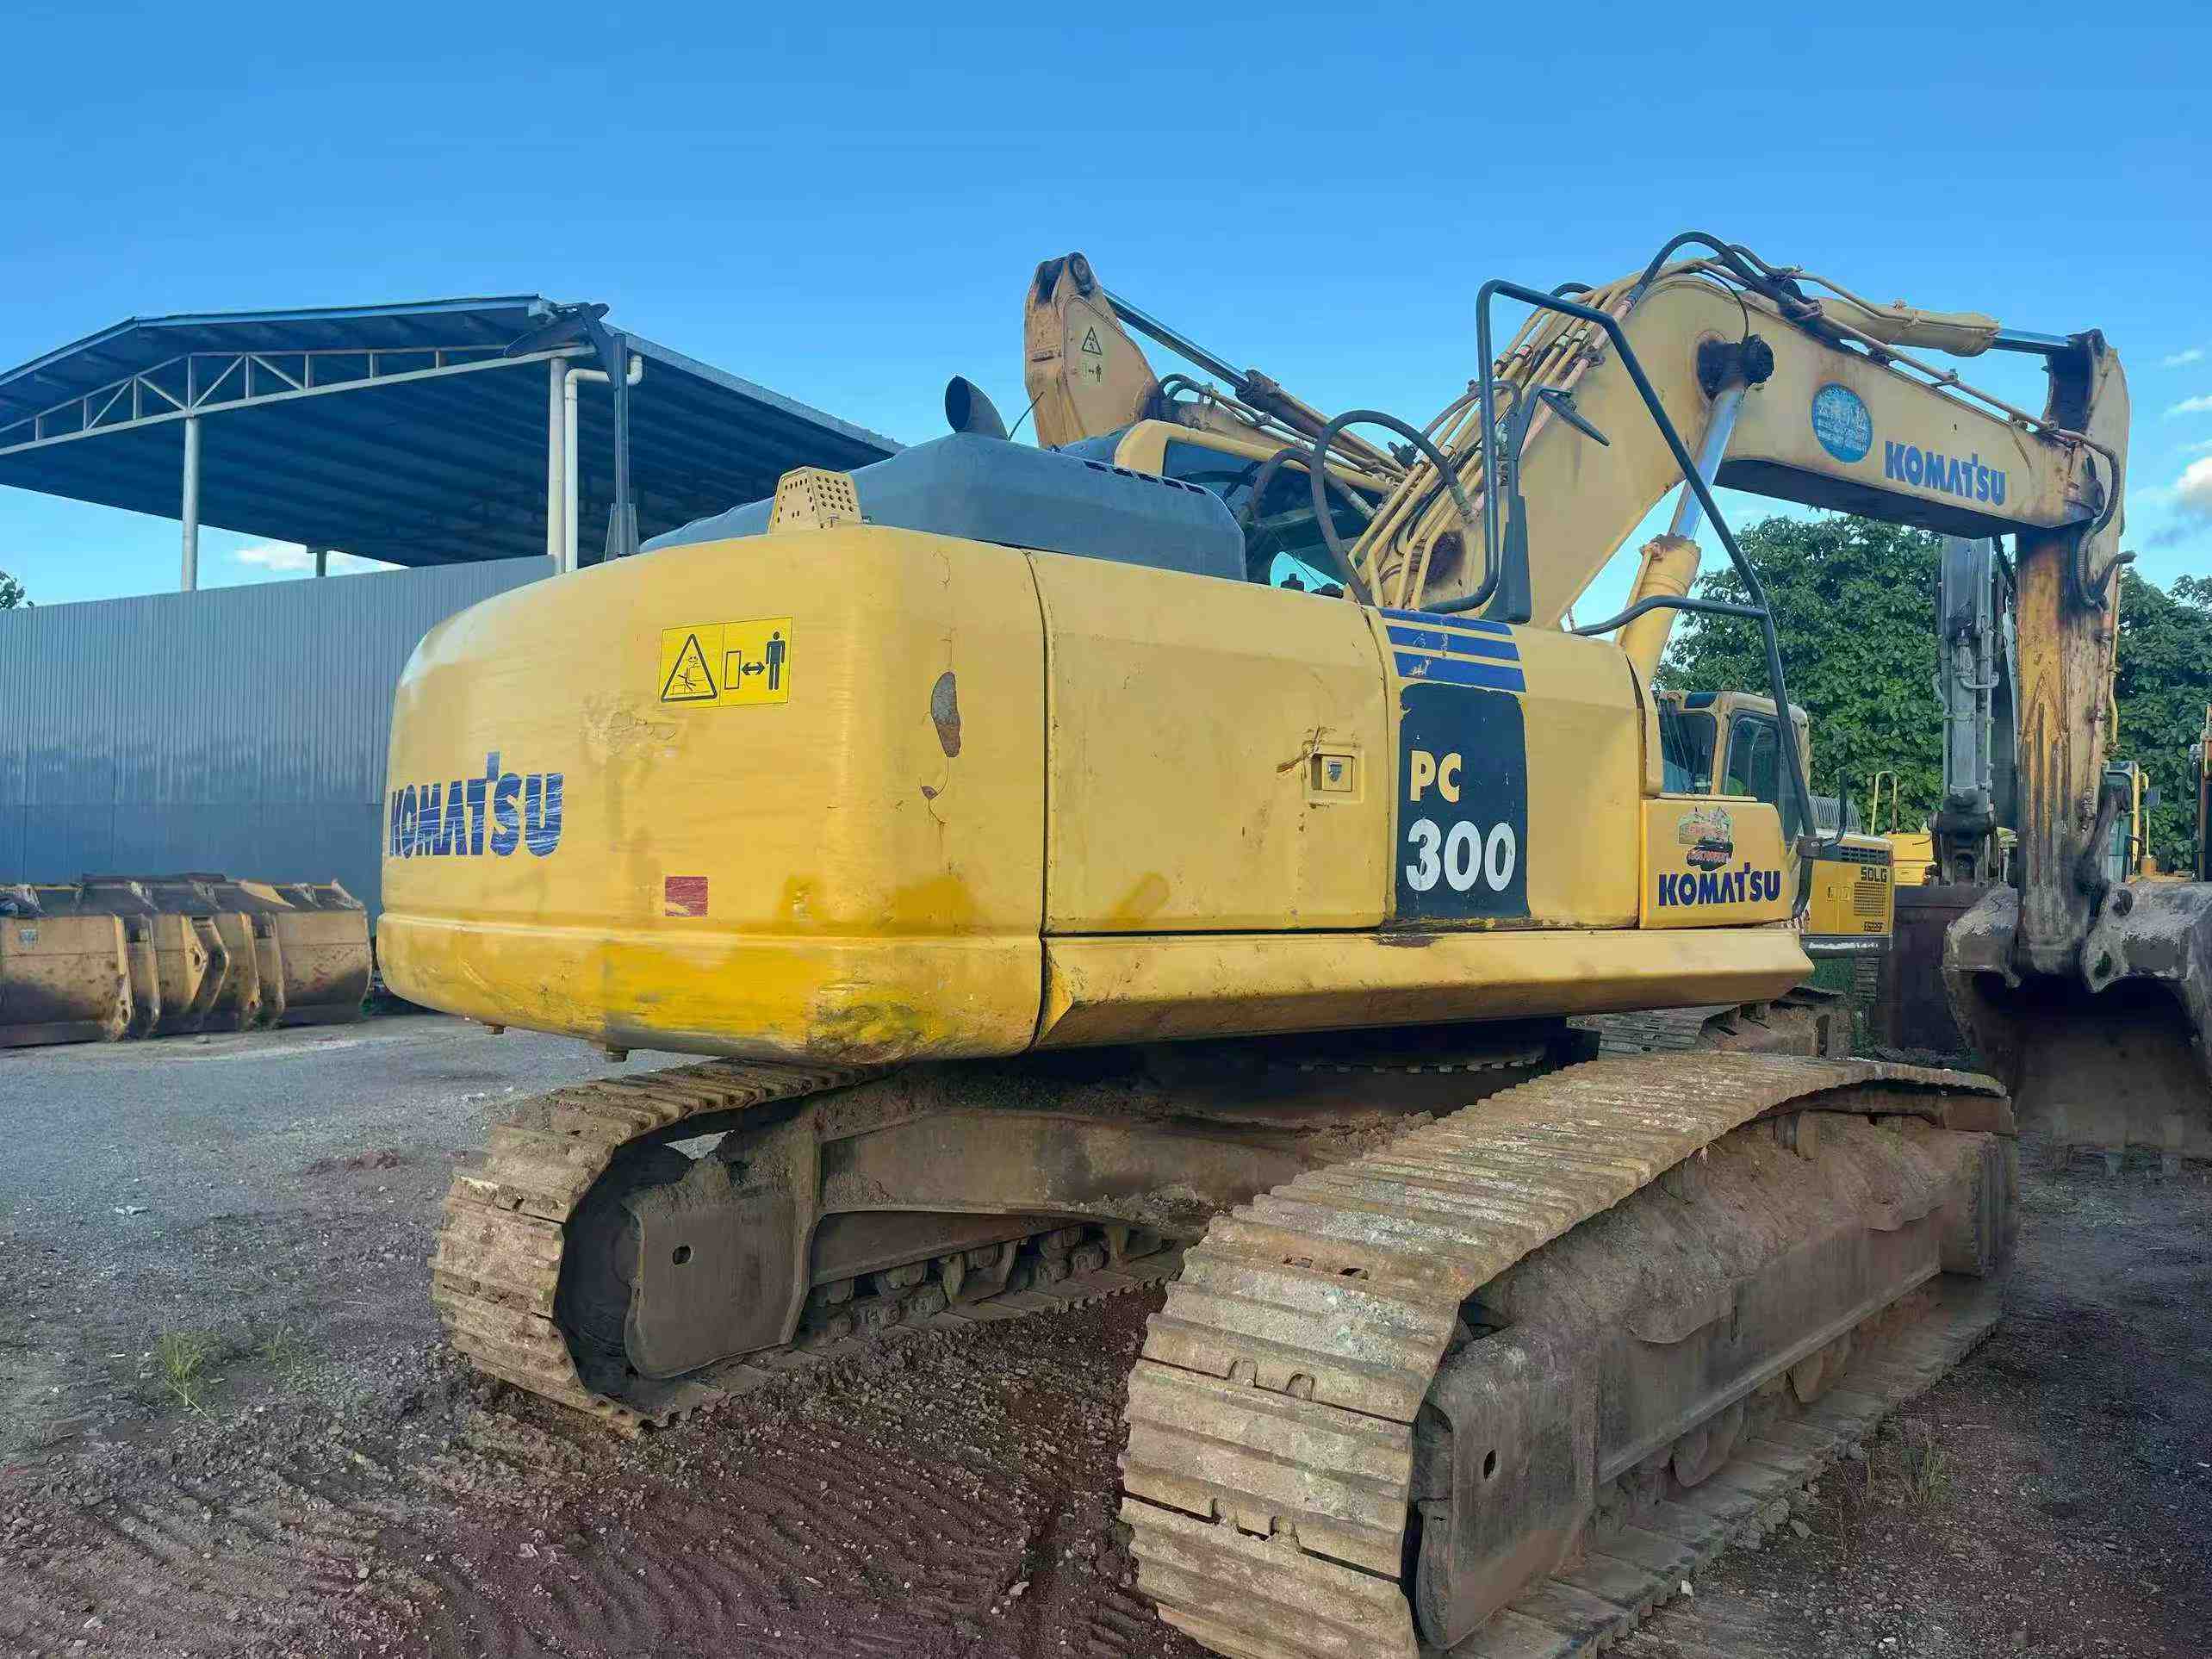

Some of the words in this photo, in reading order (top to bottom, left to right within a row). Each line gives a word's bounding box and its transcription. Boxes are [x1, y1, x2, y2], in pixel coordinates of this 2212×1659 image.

[1885, 440, 2006, 506] KOMATSU
[389, 750, 564, 859] KOMATSU
[1409, 750, 1462, 803] PC
[1406, 818, 1516, 892] 300
[1658, 861, 1781, 906] KOMATSU
